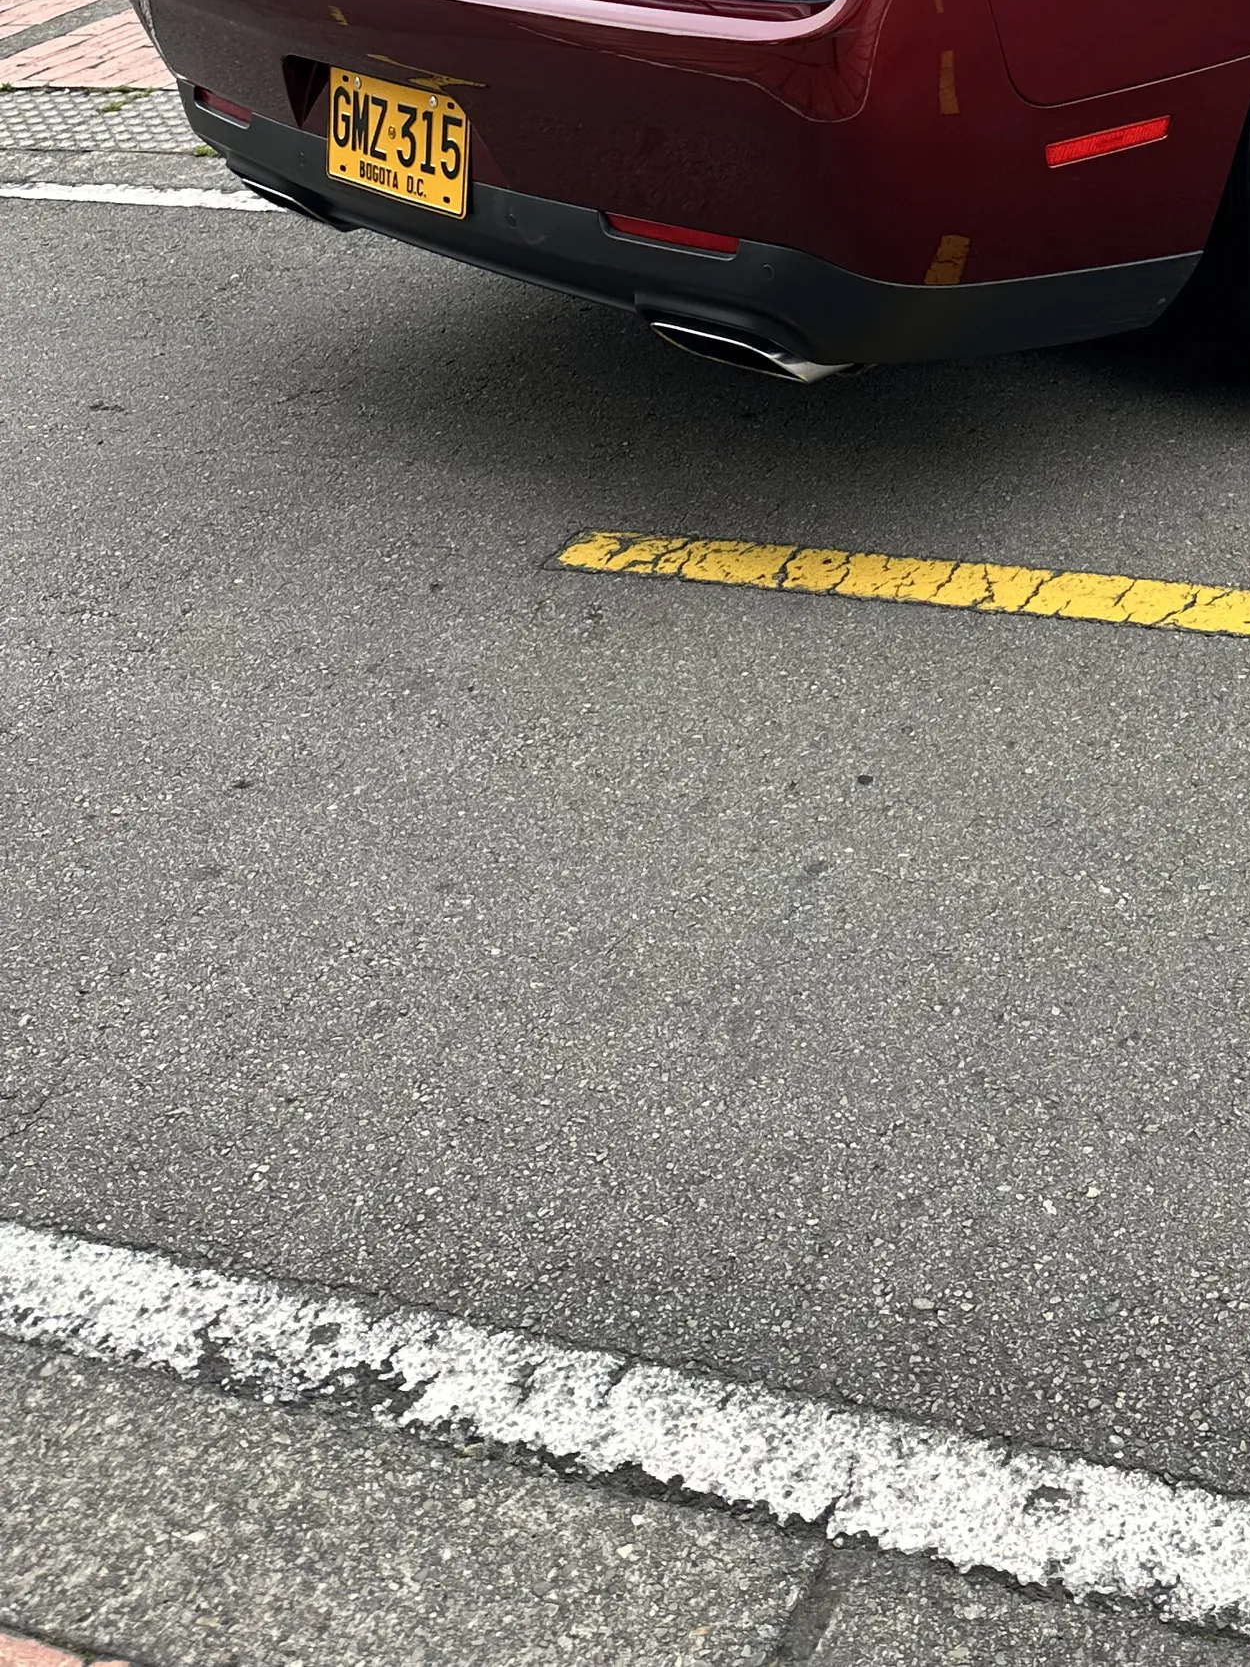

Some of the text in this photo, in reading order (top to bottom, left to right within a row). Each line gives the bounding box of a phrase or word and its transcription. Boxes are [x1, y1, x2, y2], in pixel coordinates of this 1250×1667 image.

[333, 85, 463, 181] GMZ 315
[359, 160, 427, 198] BOGOTA D.C.
